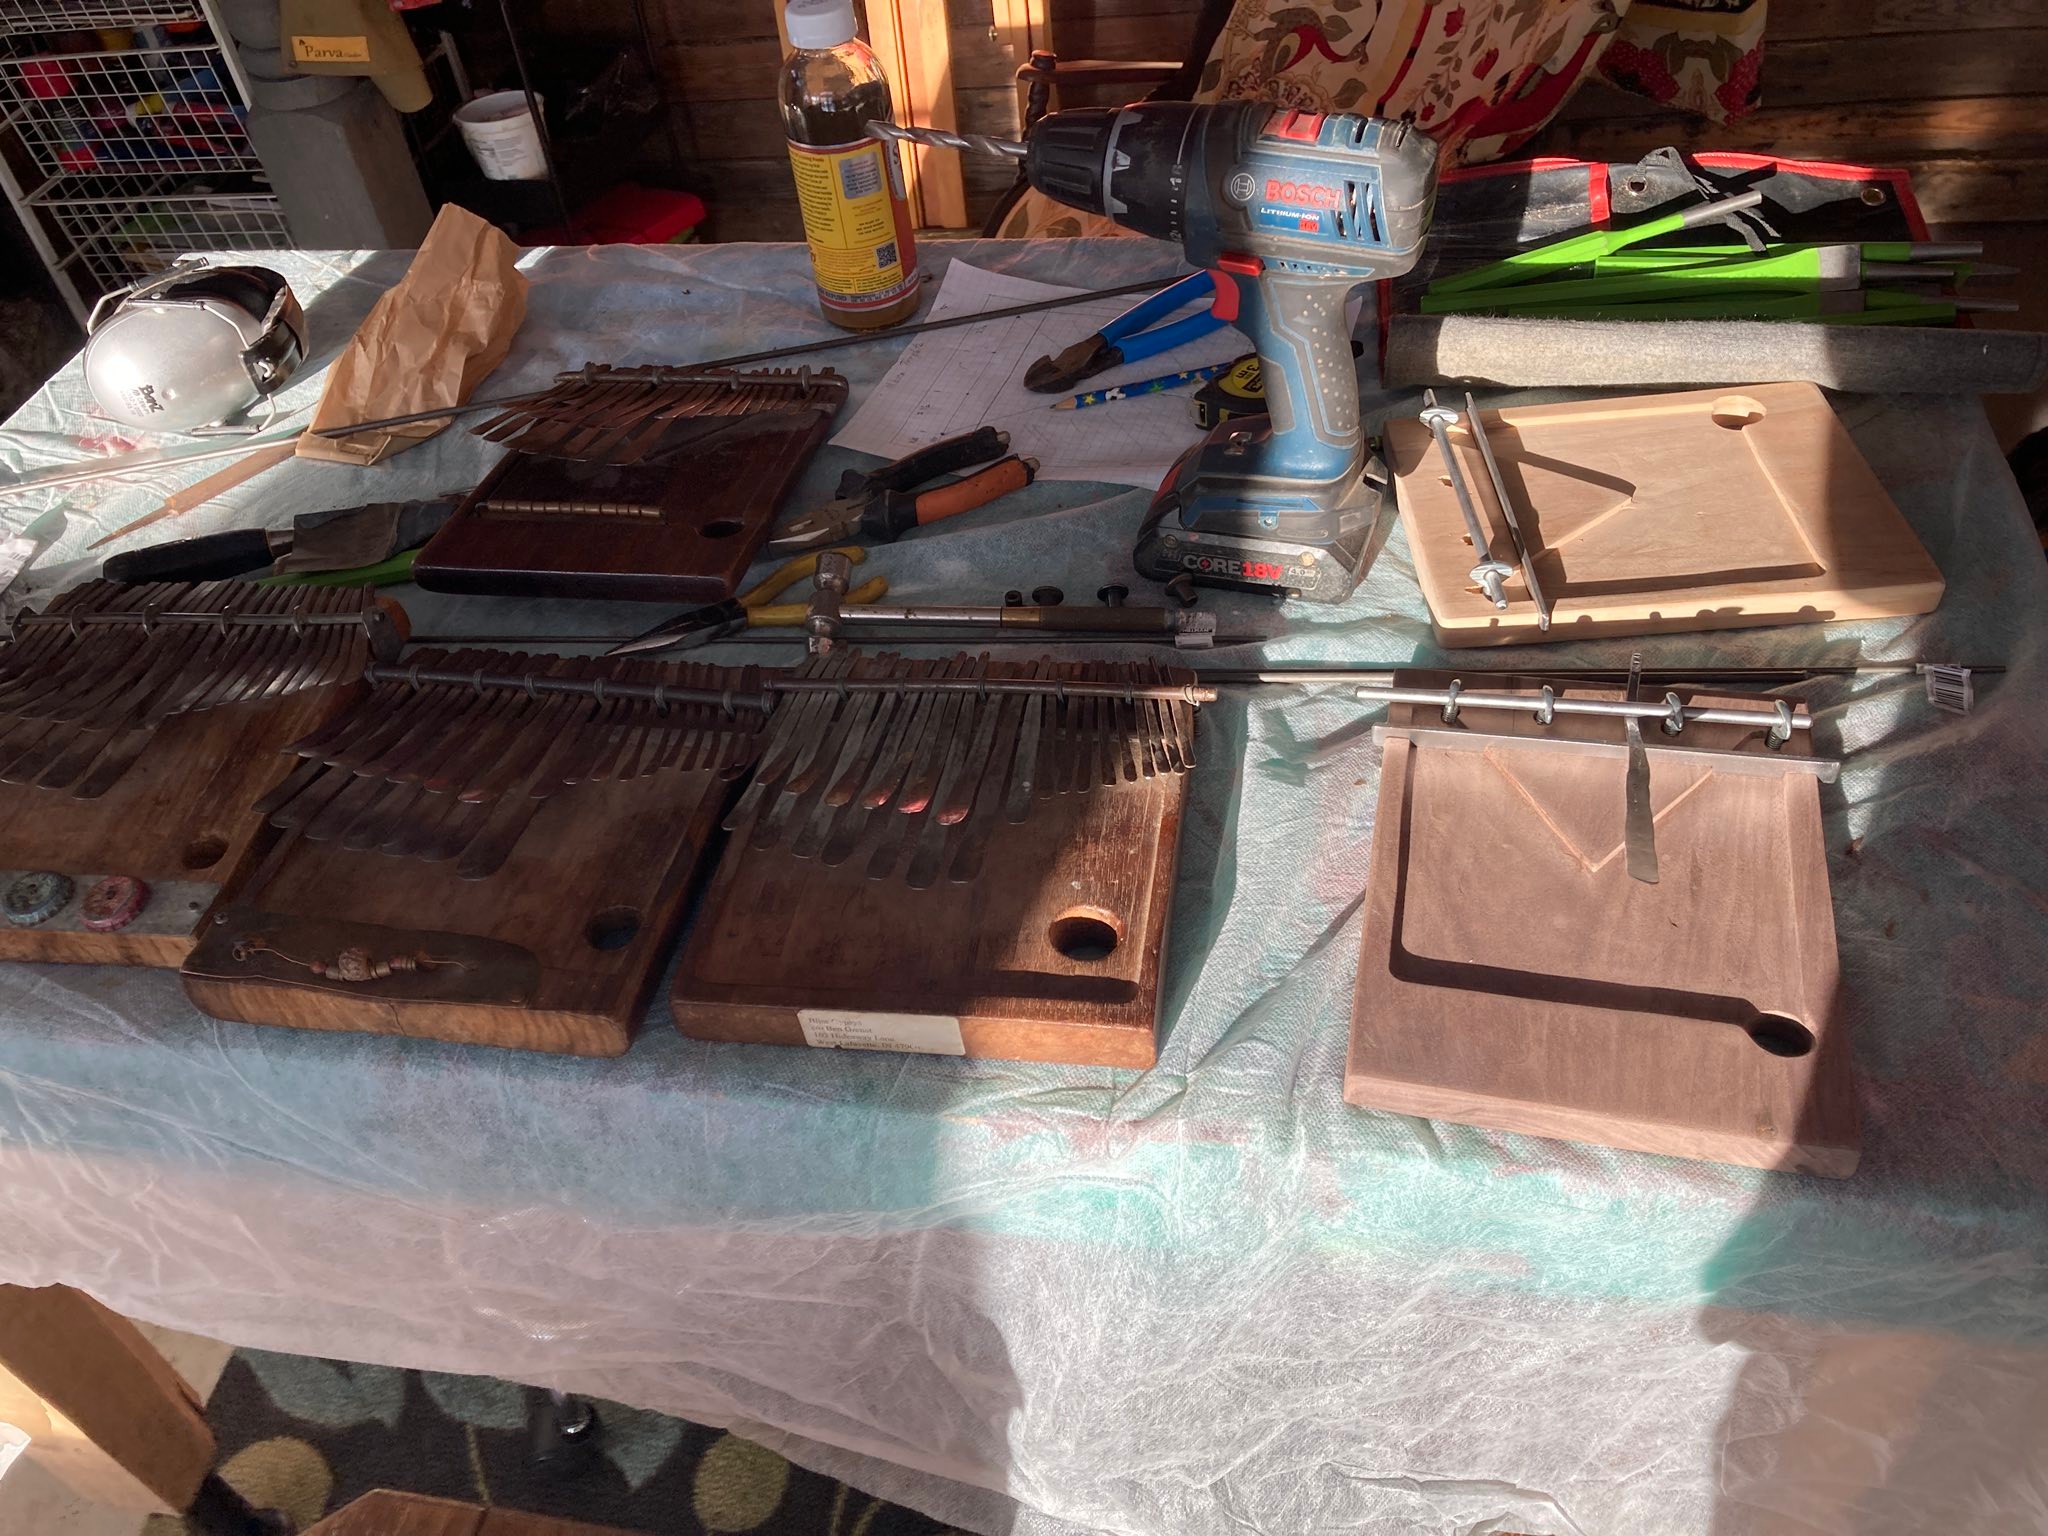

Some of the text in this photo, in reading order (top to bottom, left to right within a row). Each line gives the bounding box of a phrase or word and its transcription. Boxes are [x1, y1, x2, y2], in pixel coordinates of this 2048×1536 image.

[304, 45, 344, 58] Parva
[1265, 179, 1342, 209] BOSCH
[1260, 207, 1320, 221] LITHIUM-ION
